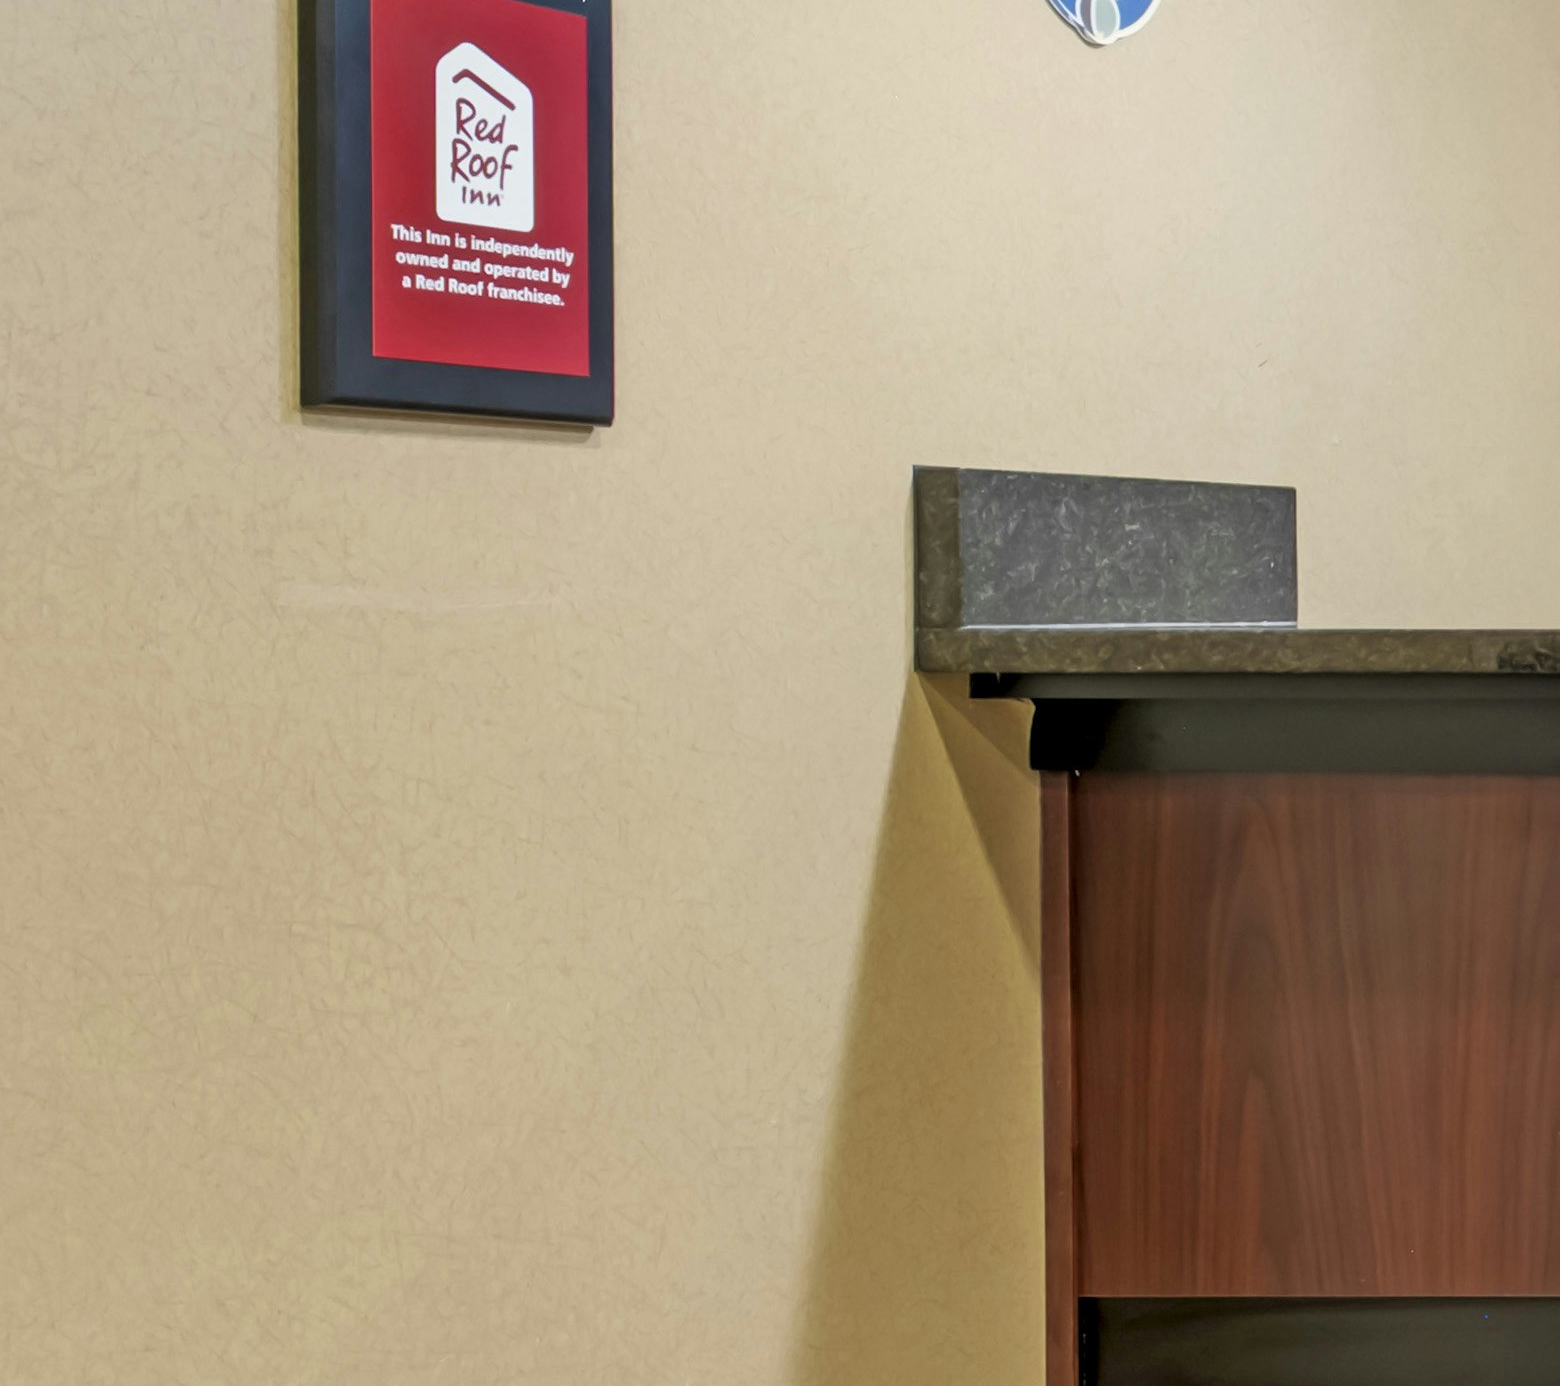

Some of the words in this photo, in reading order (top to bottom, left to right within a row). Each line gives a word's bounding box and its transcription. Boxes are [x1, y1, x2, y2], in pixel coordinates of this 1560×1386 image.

[456, 97, 506, 143] Red
[451, 138, 518, 190] Roof
[391, 224, 422, 243] This
[427, 230, 451, 247] Inn
[455, 233, 467, 249] is
[471, 235, 574, 267] independently
[395, 252, 448, 269] owned
[452, 258, 481, 274] and
[484, 262, 549, 280] operated
[552, 268, 570, 289] by
[402, 275, 412, 288] a
[416, 274, 445, 292] Red
[449, 278, 485, 297] Roof
[487, 282, 565, 307] franchisee.
